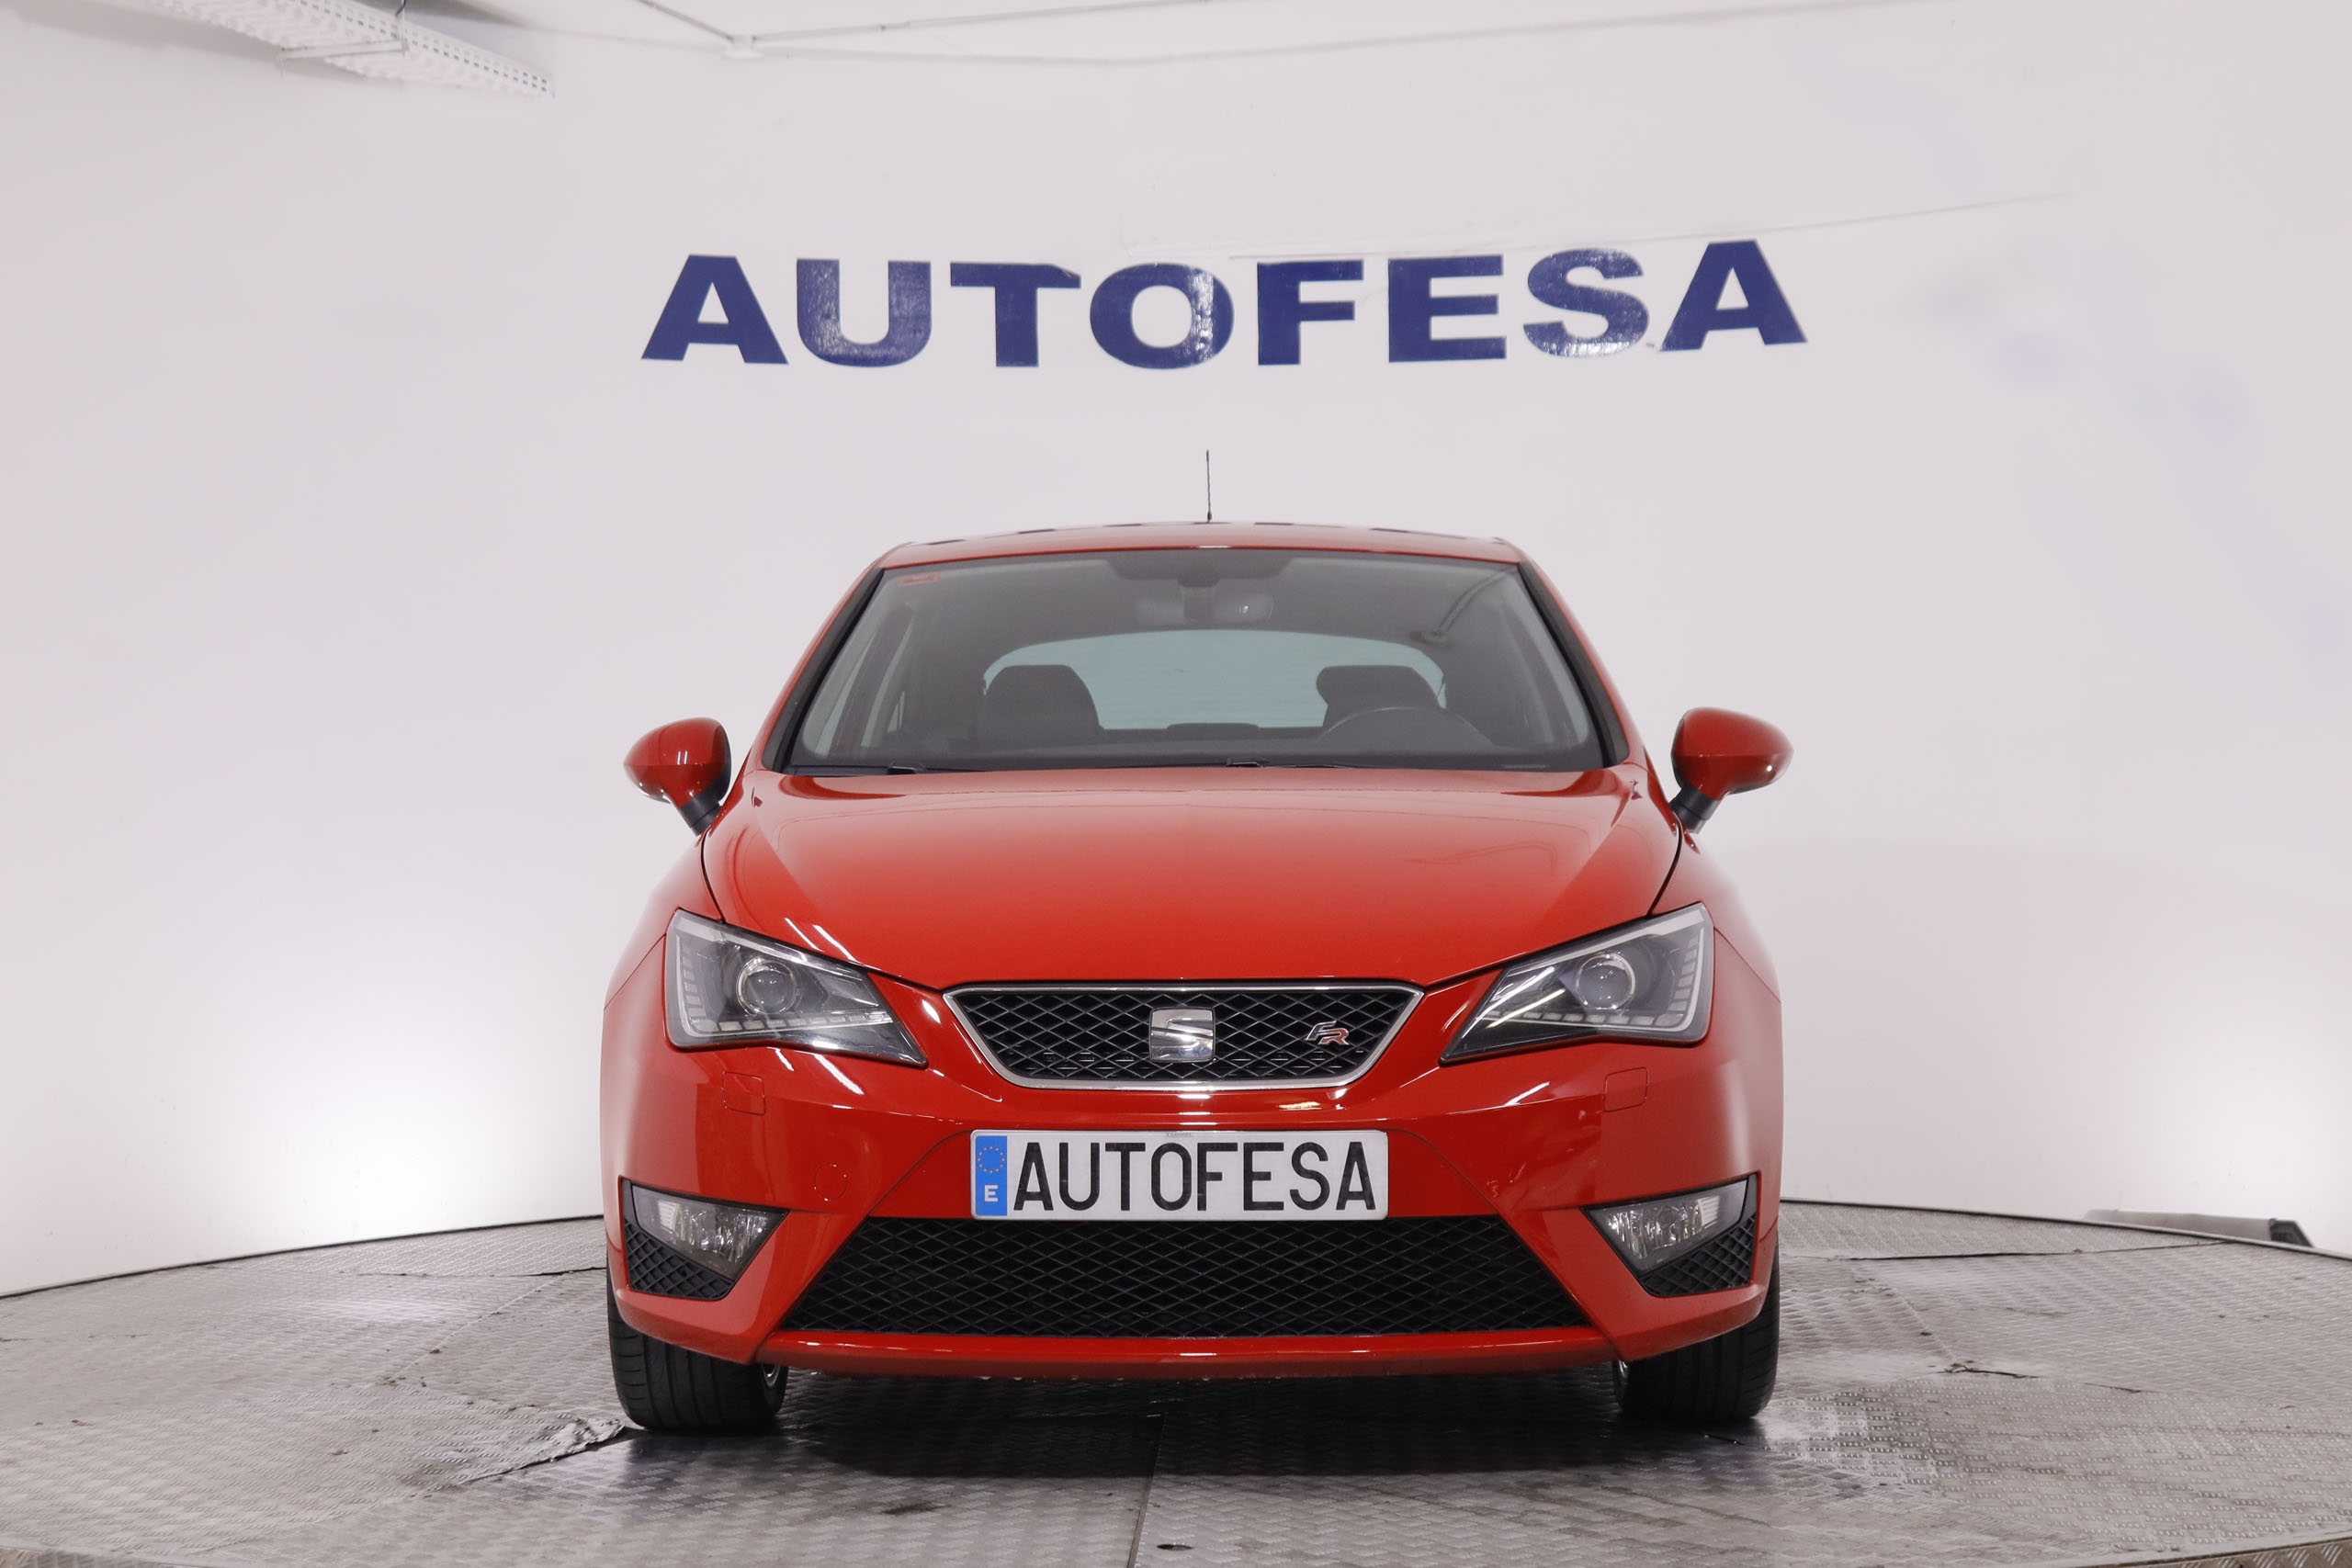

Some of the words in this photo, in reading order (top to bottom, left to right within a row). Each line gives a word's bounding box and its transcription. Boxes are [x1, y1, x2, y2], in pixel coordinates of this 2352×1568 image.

[642, 239, 1809, 370] AUTOFESA
[1305, 1020, 1350, 1045] FR
[984, 1184, 999, 1202] E
[1013, 1142, 1376, 1212] AUTOFESA
